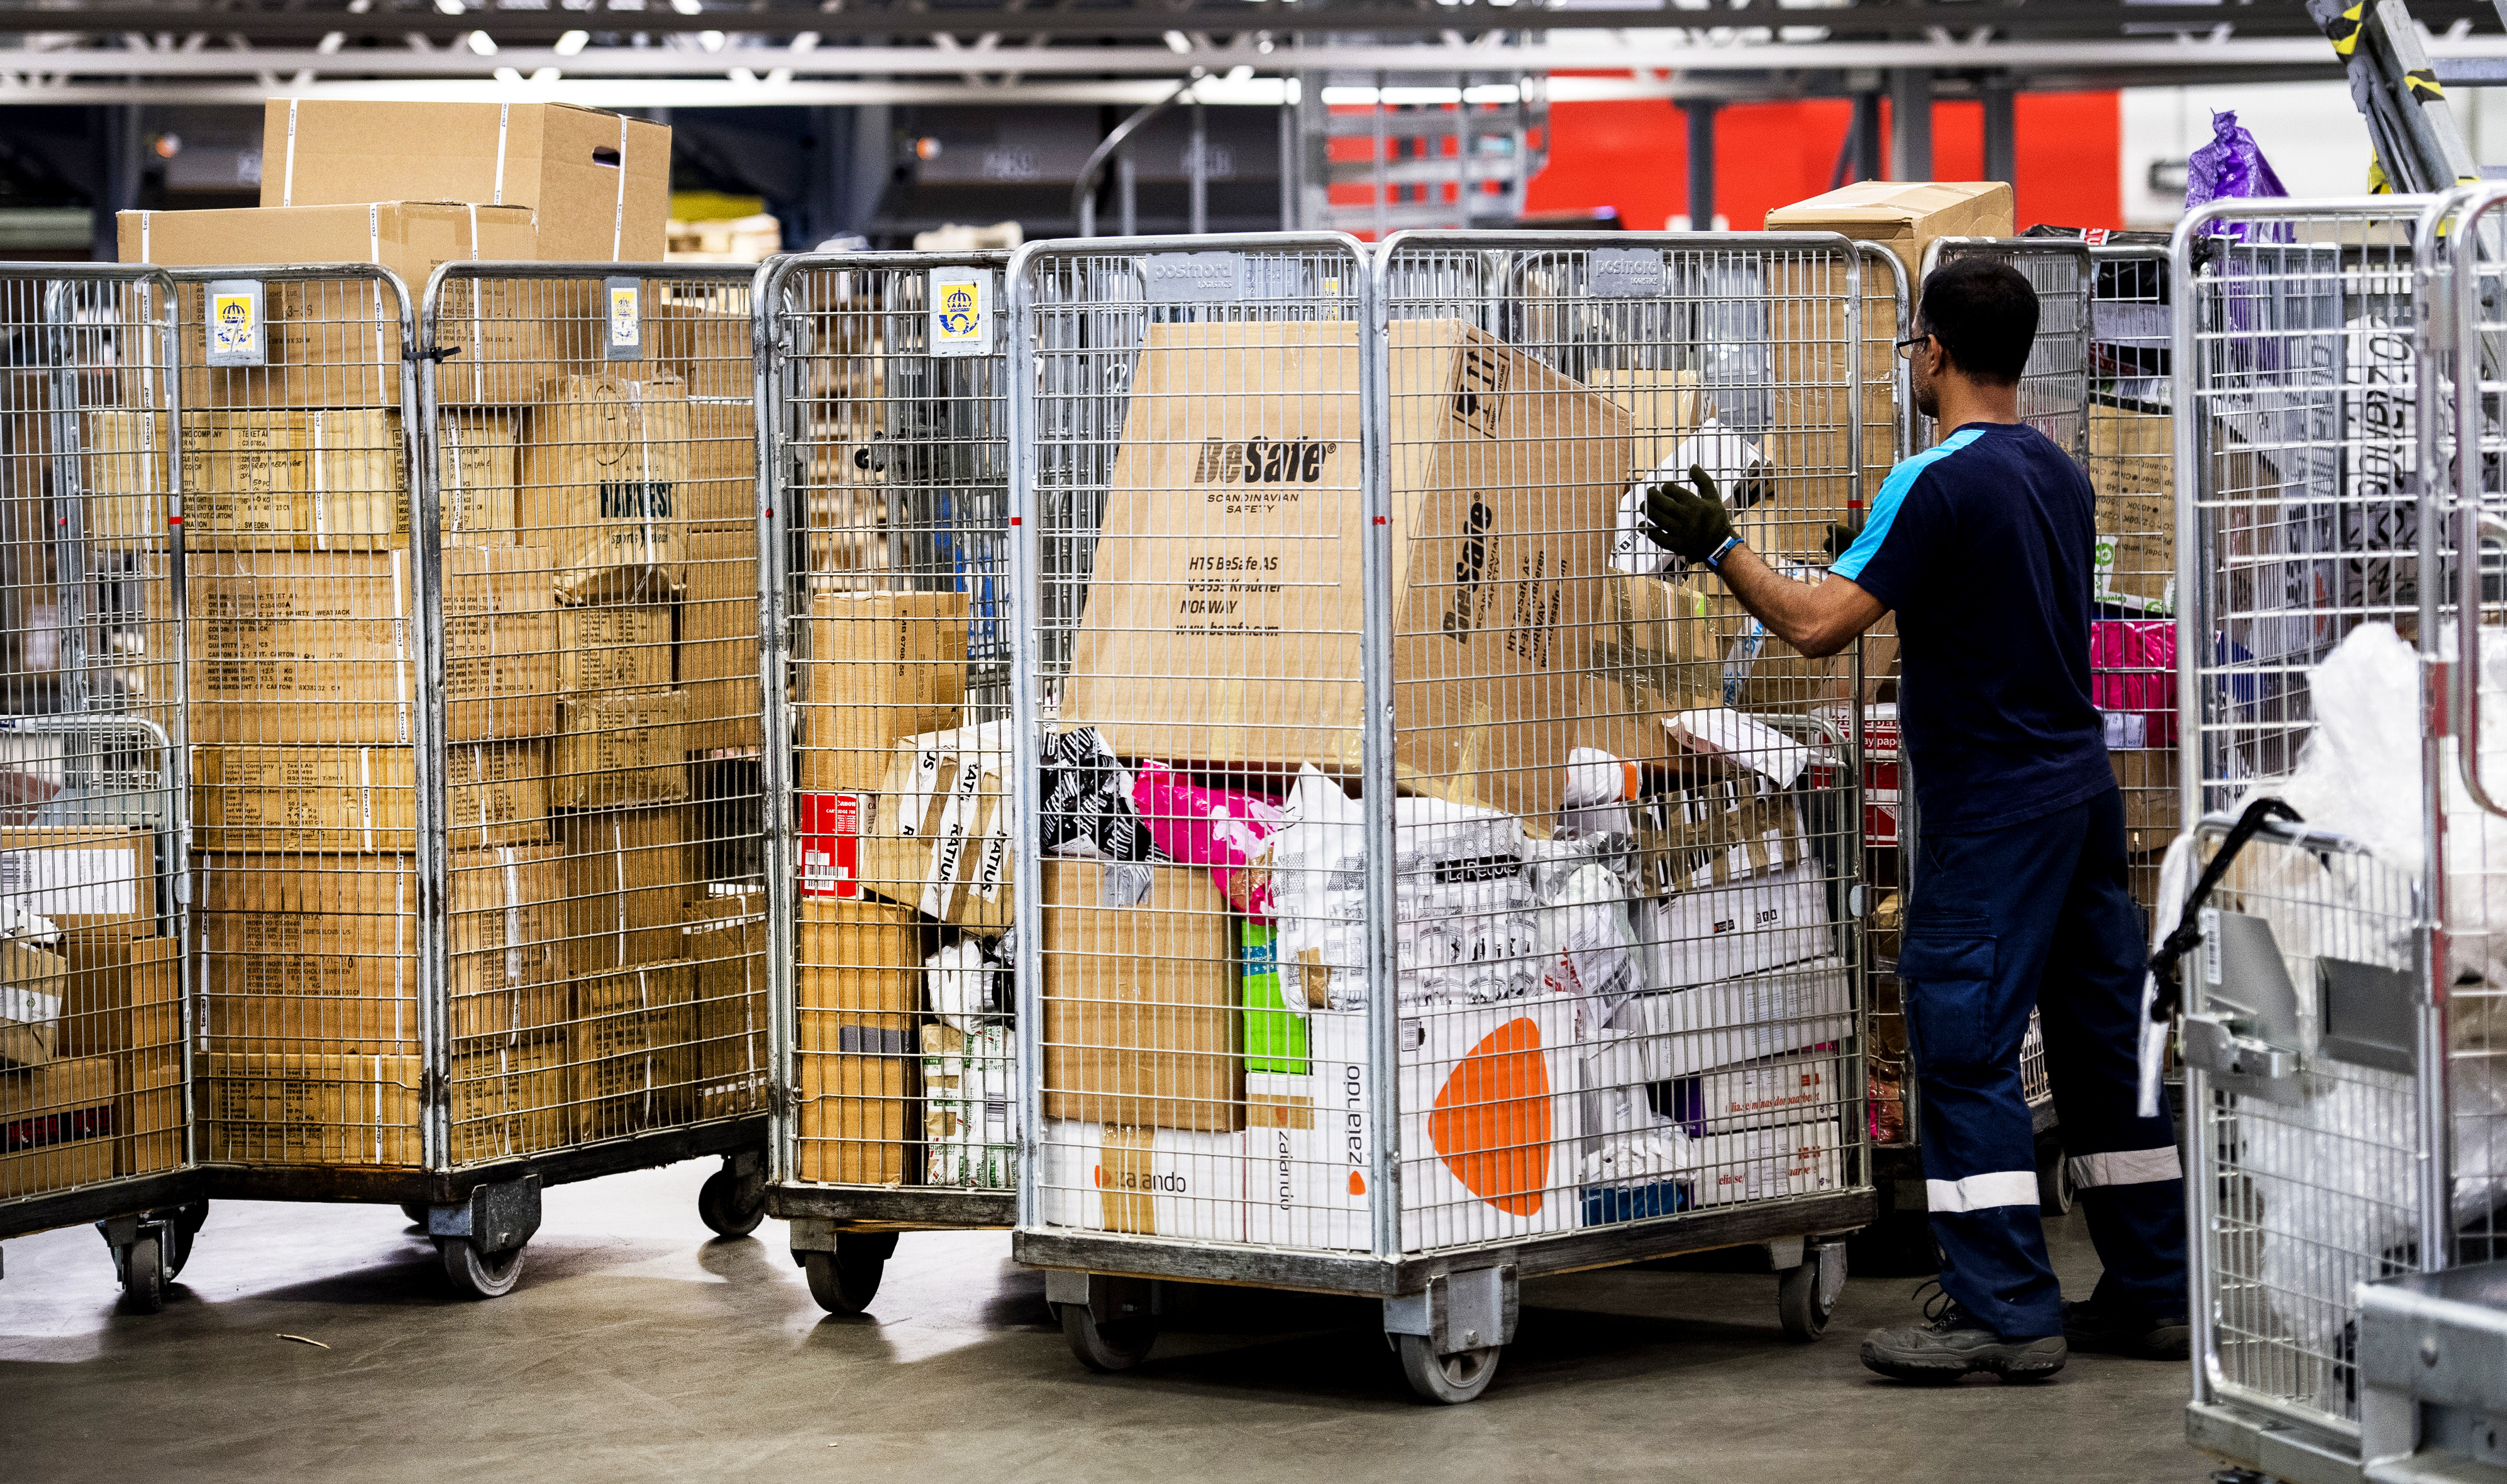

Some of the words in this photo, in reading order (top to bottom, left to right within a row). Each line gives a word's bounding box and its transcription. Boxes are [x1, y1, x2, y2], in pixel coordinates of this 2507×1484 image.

[1155, 260, 1232, 282] postnord
[1596, 258, 1658, 277] postnord
[1197, 280, 1232, 289] LOGISTICS
[1115, 1171, 1186, 1193] zaando
